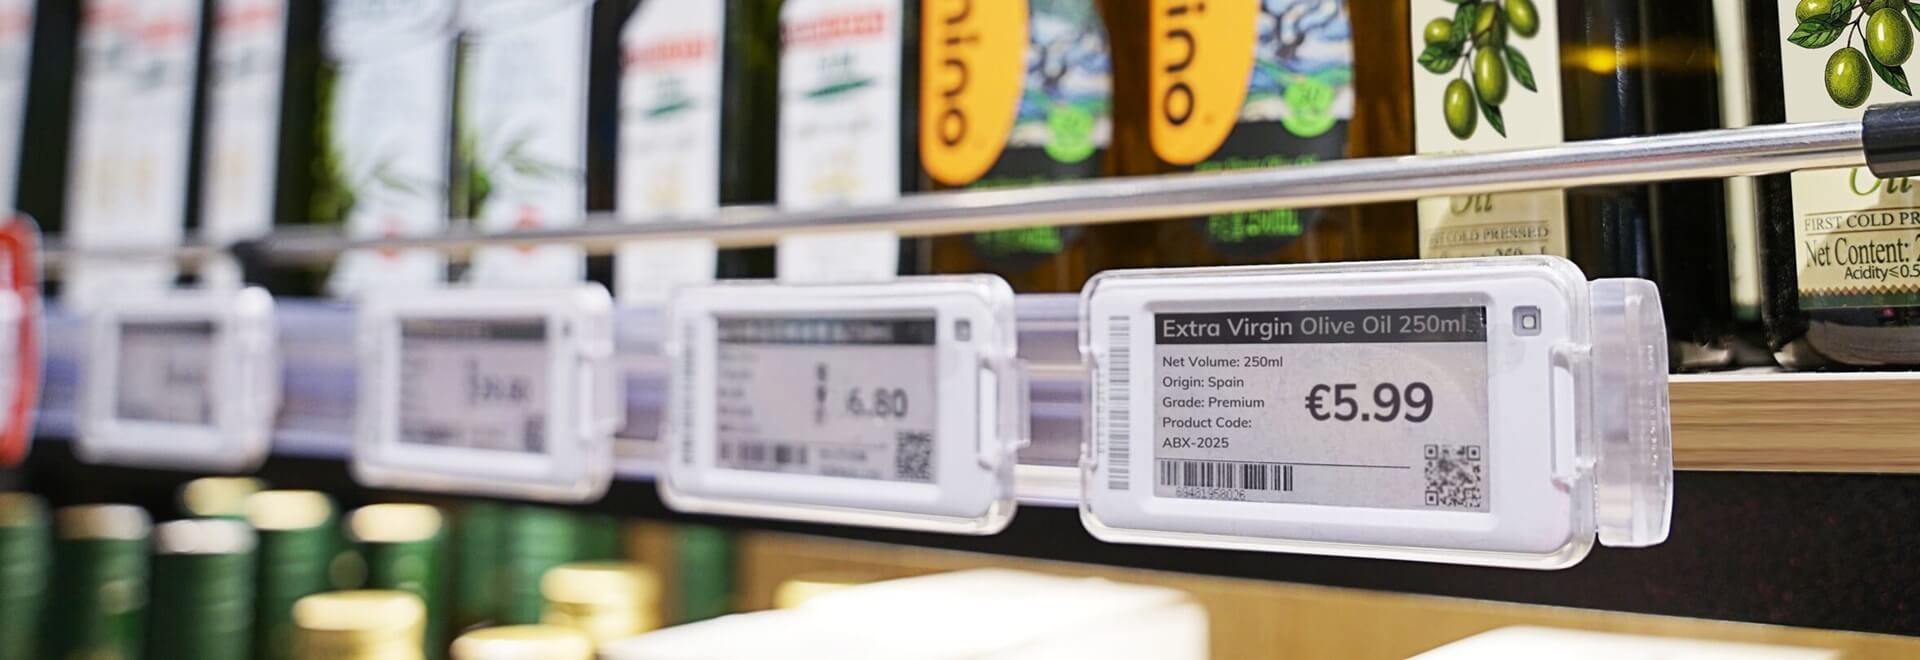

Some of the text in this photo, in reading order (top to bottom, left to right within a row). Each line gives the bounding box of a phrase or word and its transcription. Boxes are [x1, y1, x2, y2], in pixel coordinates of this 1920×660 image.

[1805, 216, 1842, 232] FIRST
[1846, 213, 1895, 229] COLD
[1483, 224, 1549, 241] PRESSED
[1806, 240, 1831, 268] Net
[1835, 237, 1909, 266] Content:
[1162, 313, 1467, 341] Extra Virgin Olive Oil 250ml
[1162, 355, 1284, 368] Net Volume: 250ml
[1162, 376, 1244, 390] Origin: Spain
[1162, 396, 1265, 409] Grade: Premium
[1305, 381, 1434, 424] €5.99
[1162, 417, 1252, 429] Product Code:
[1162, 437, 1230, 449] ABX-2025
